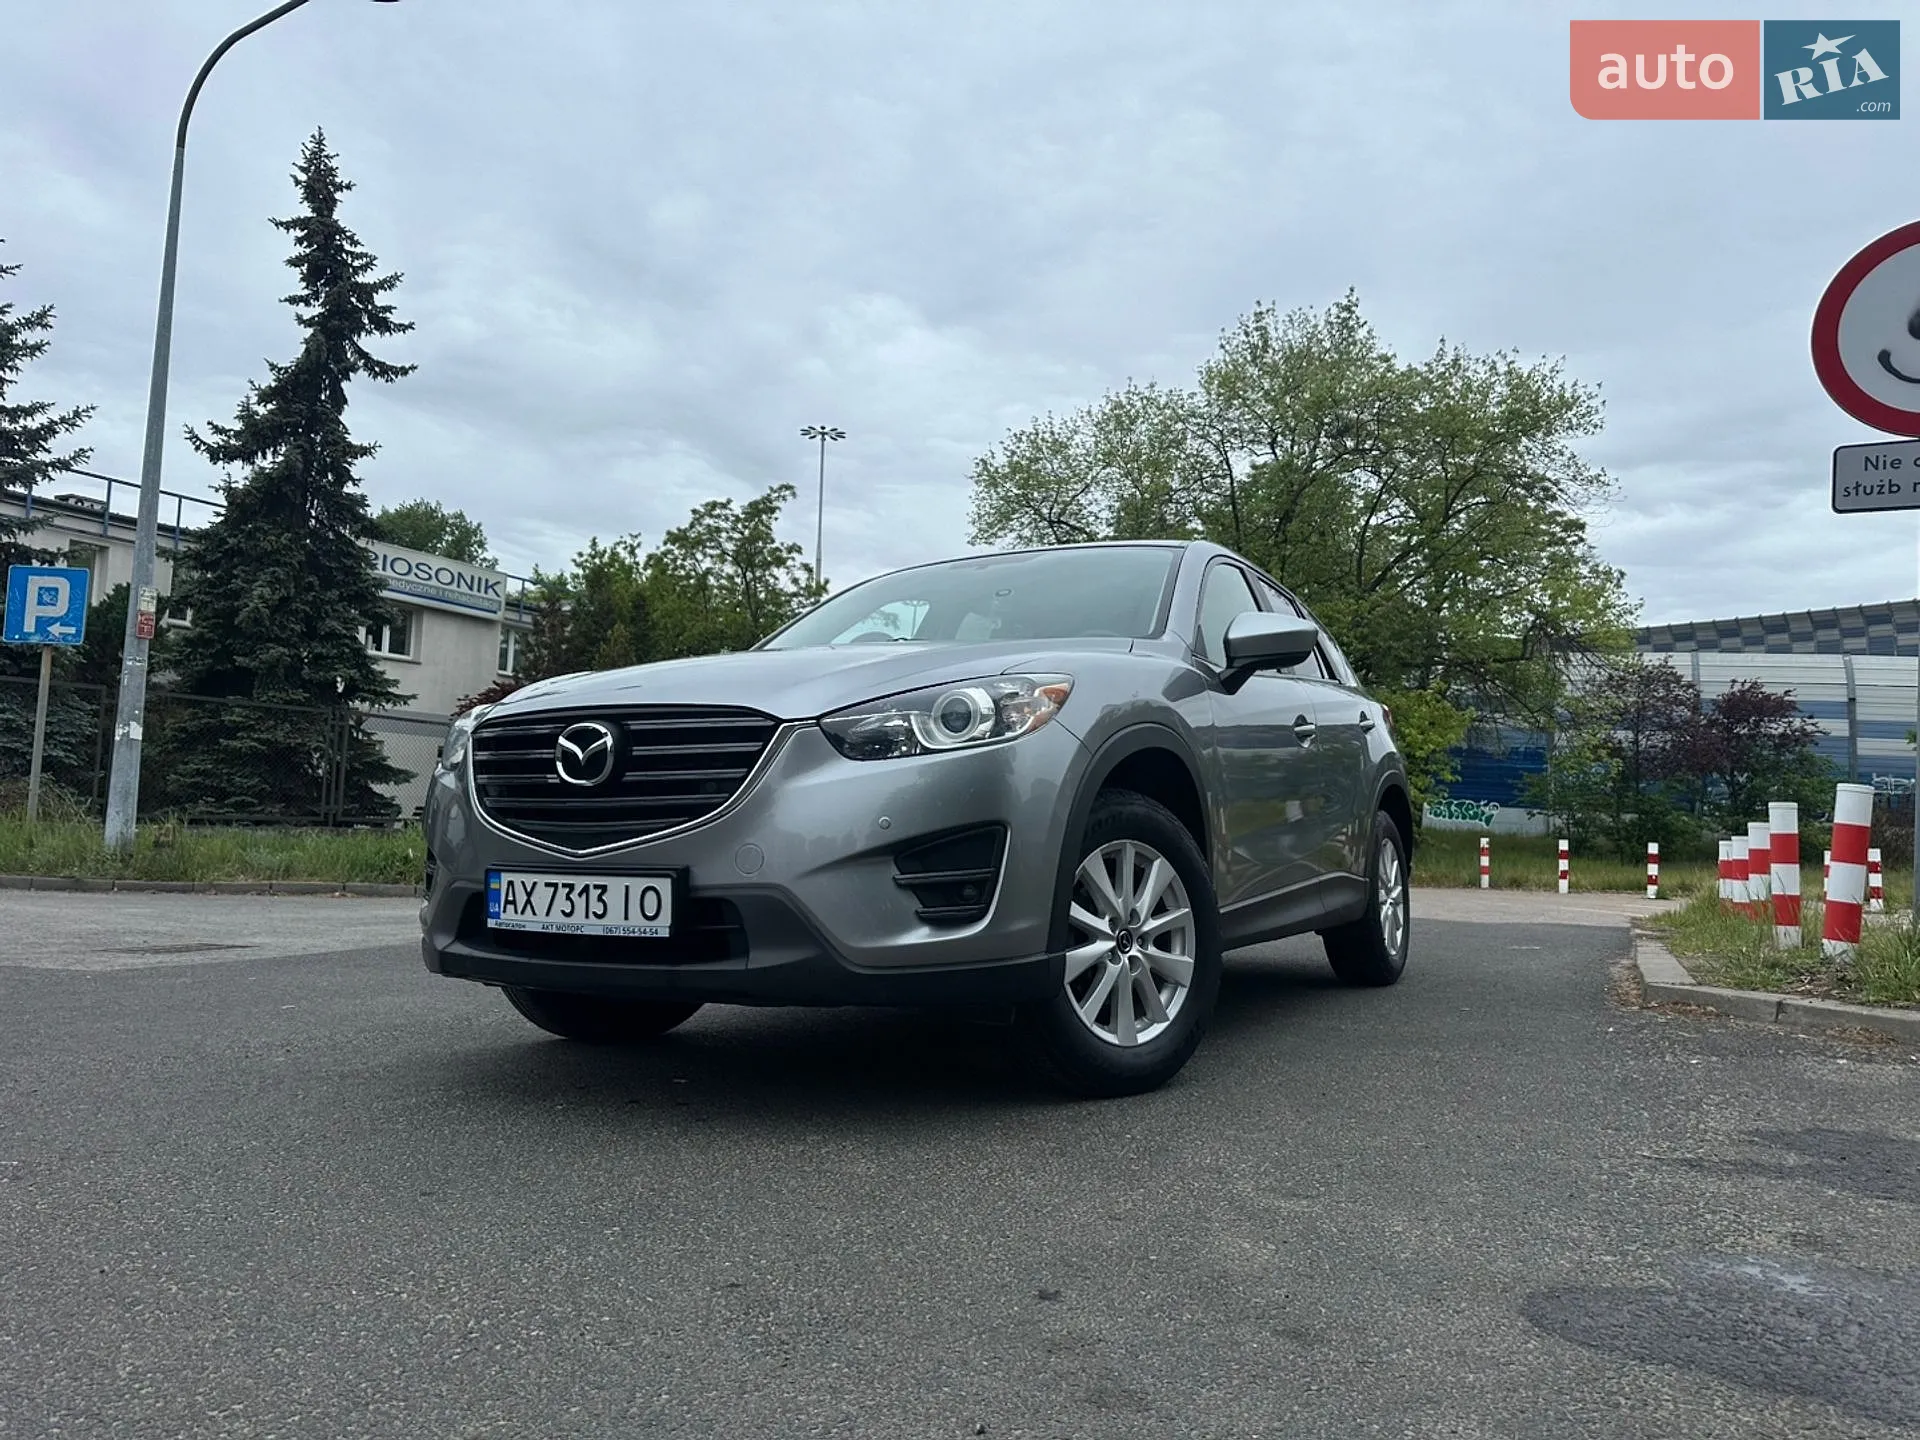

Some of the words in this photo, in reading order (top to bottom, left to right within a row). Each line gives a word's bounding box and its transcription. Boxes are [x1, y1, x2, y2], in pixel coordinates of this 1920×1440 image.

[1864, 454, 1902, 472] Nie
[1843, 478, 1901, 497] służb
[23, 575, 71, 633] P
[502, 880, 538, 916] AX
[544, 881, 609, 920] 7313
